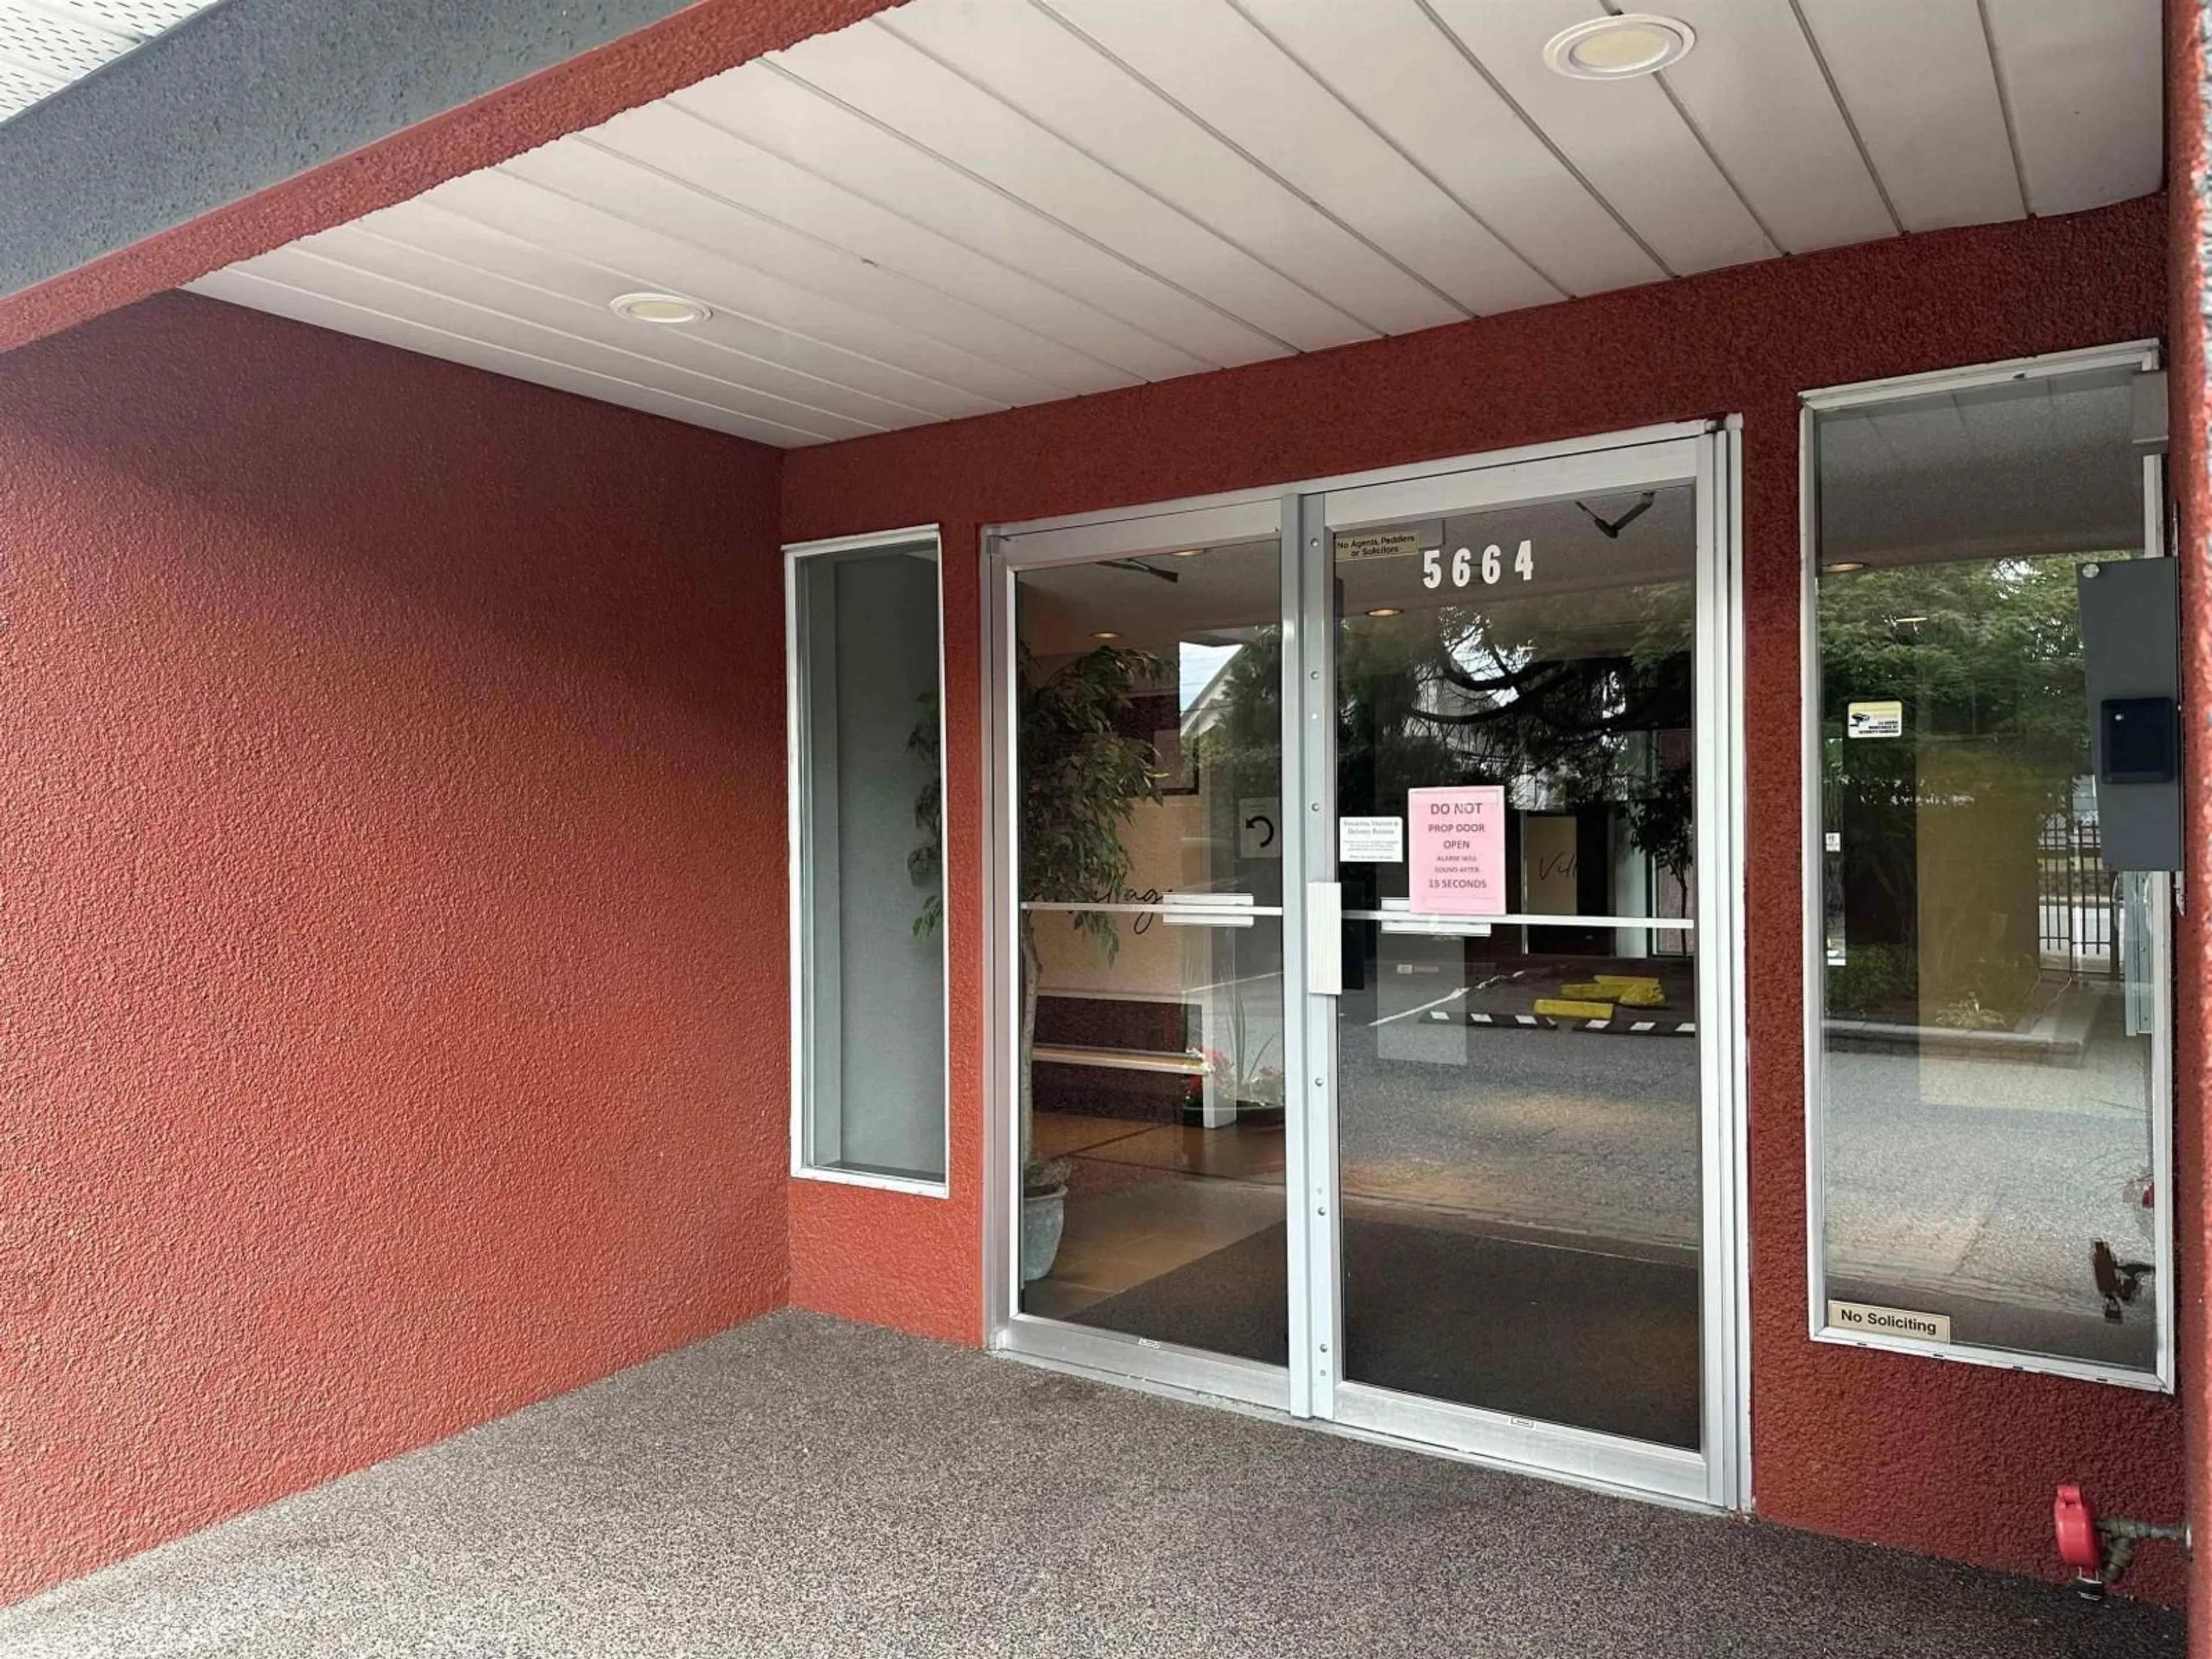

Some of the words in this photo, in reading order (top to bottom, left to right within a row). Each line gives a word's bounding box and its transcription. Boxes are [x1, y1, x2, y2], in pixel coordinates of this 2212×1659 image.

[1381, 535, 1415, 544] Peddlers
[1423, 540, 1533, 588] 5664
[1430, 803, 1450, 815] DO
[1454, 802, 1483, 814] NOT
[1428, 824, 1453, 832] PROP
[1456, 824, 1484, 832] DOOR
[1444, 840, 1470, 849] OPEN
[1429, 879, 1440, 888] 15
[1441, 879, 1487, 888] SECONDS
[1841, 1309, 1862, 1323] No
[1868, 1313, 1936, 1335] Soliciting
